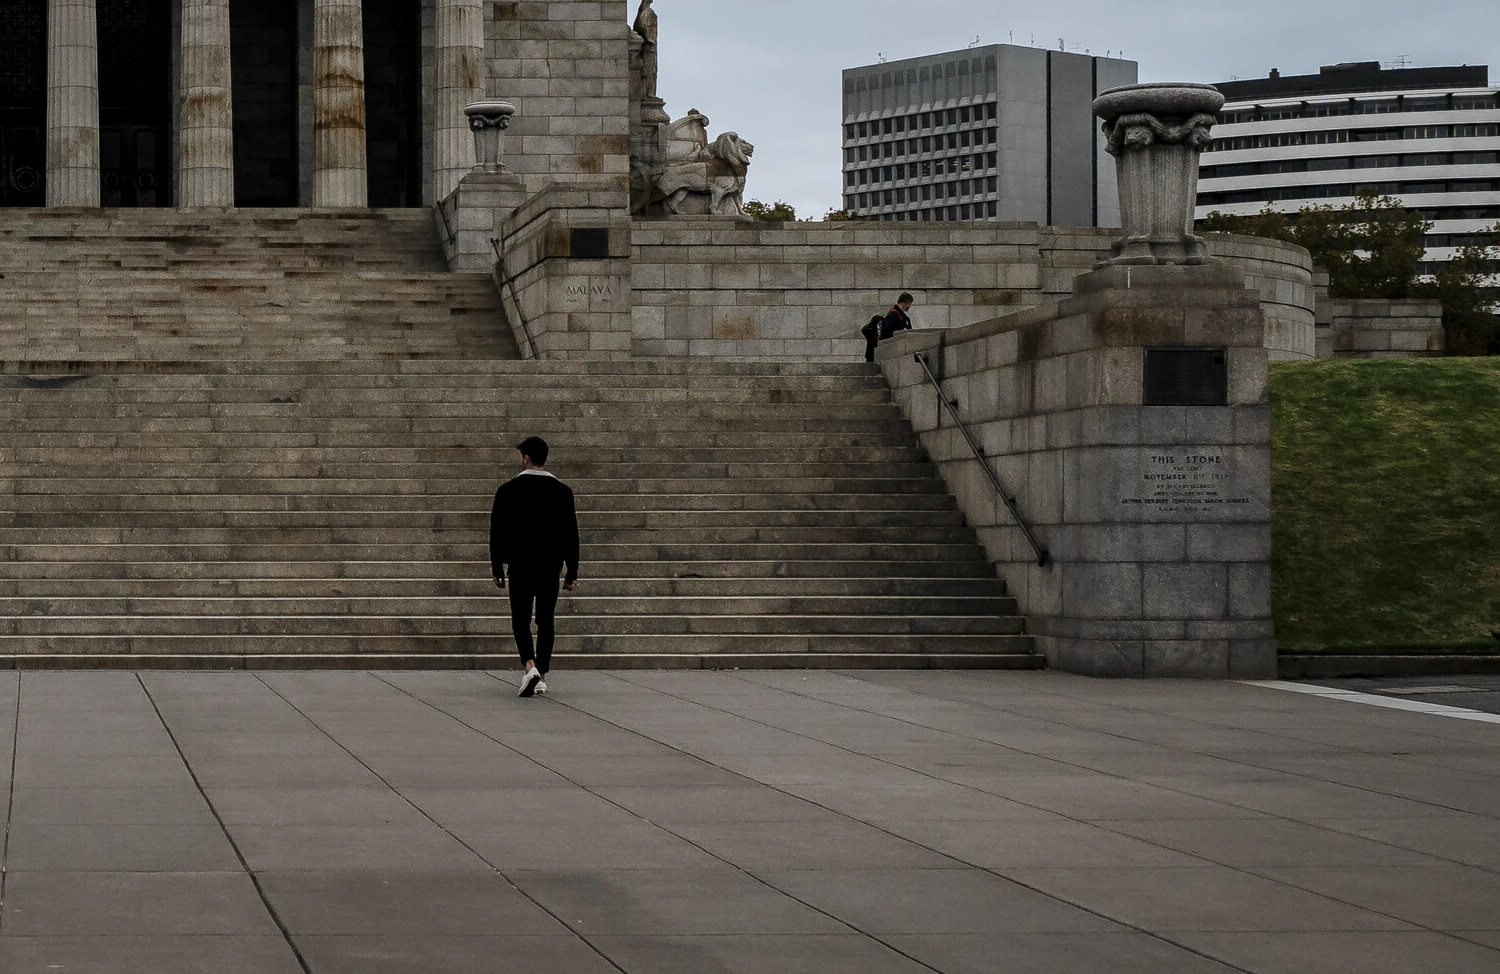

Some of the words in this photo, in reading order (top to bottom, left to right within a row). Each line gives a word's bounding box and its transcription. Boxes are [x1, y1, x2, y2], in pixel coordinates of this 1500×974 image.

[567, 285, 612, 295] MALAYA
[1151, 456, 1175, 464] THIS
[1185, 456, 1221, 464] STONE
